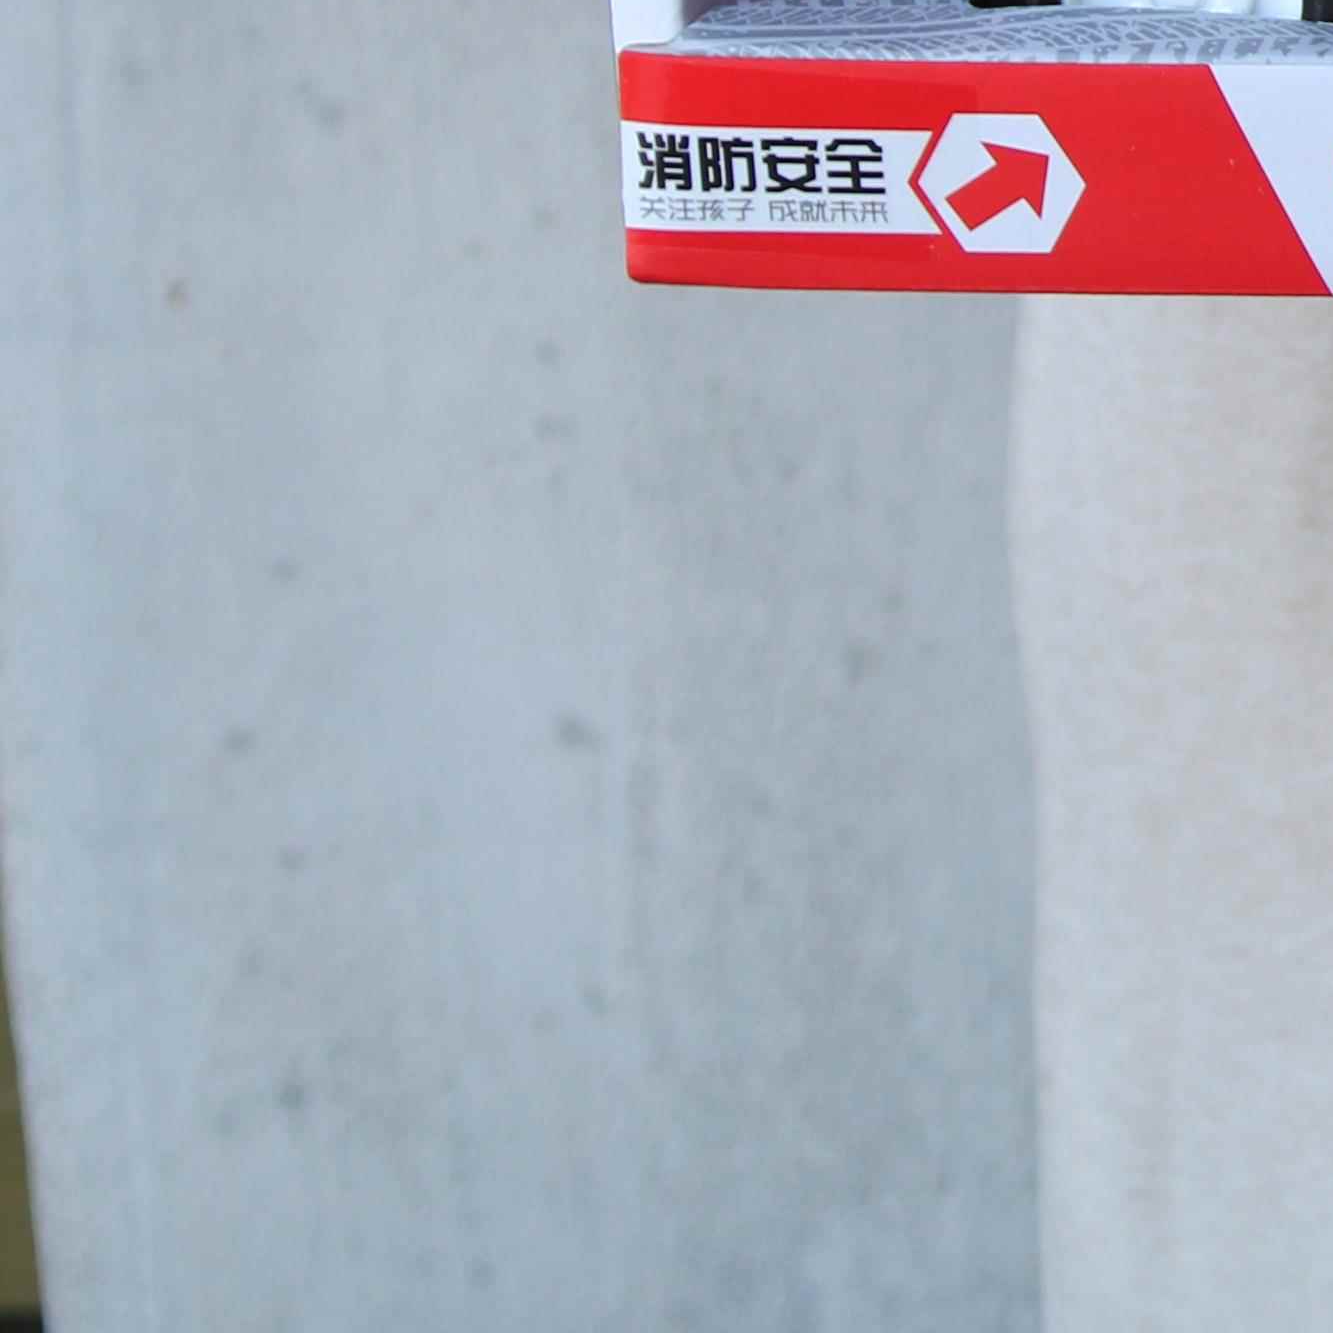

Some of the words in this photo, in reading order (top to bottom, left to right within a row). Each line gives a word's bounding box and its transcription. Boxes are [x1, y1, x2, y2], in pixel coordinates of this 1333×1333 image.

[634, 130, 887, 195] 消防安全
[639, 197, 756, 223] 关注孩子
[768, 198, 889, 224] 成就未来
